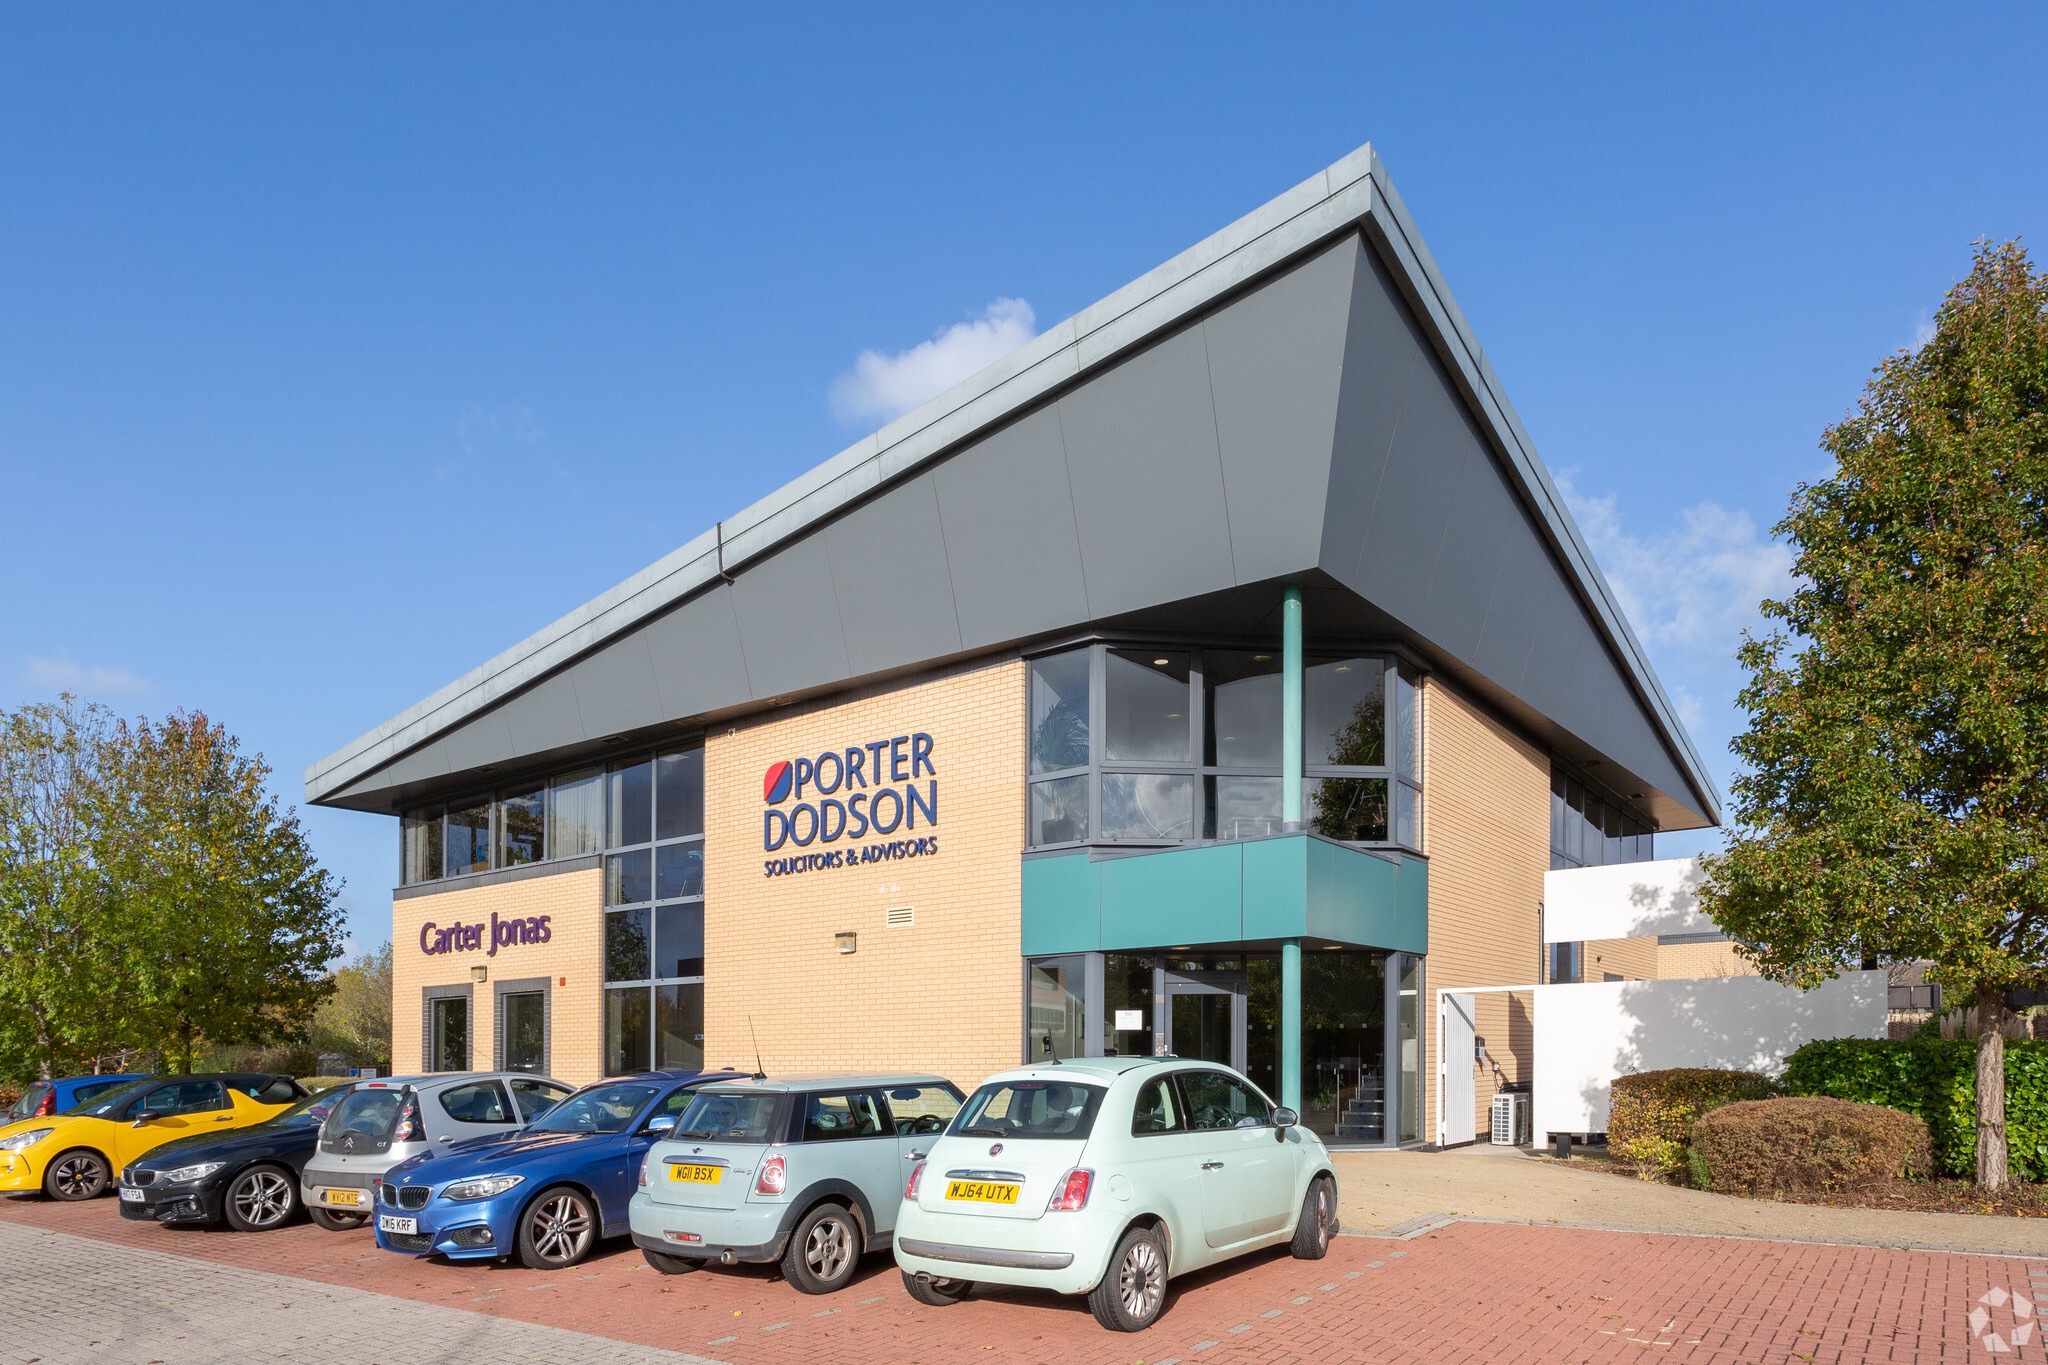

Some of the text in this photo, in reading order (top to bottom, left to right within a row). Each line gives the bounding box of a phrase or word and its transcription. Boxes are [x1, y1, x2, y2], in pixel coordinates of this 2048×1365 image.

[795, 732, 936, 800] PORTER
[764, 780, 937, 852] DODSON
[764, 836, 938, 877] SOLICITORS & ADVISORS
[420, 912, 552, 957] Carter Jonas
[676, 1166, 714, 1181] WG11 BSX
[950, 1183, 1014, 1201] WJ64 UTX
[396, 1218, 412, 1231] KRF
